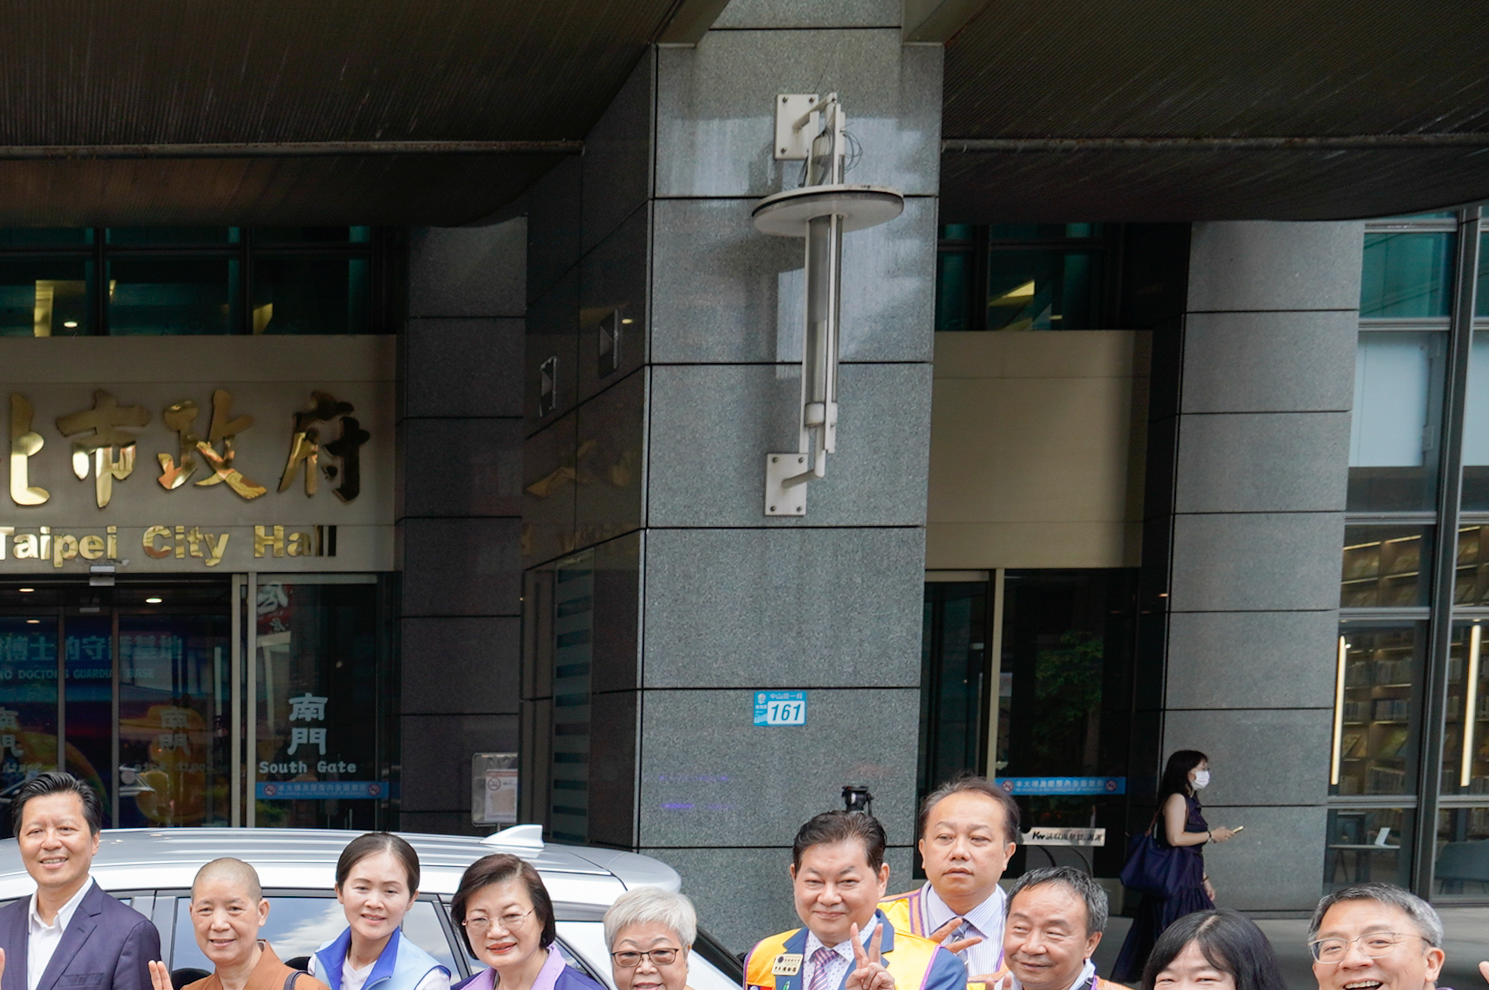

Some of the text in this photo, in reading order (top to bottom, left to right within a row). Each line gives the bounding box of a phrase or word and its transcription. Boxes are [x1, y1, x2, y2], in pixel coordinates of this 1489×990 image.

[142, 525, 230, 567] City
[253, 524, 338, 558] Hall
[287, 692, 329, 756] 南門
[771, 703, 802, 722] 161
[259, 761, 357, 774] South Gate
